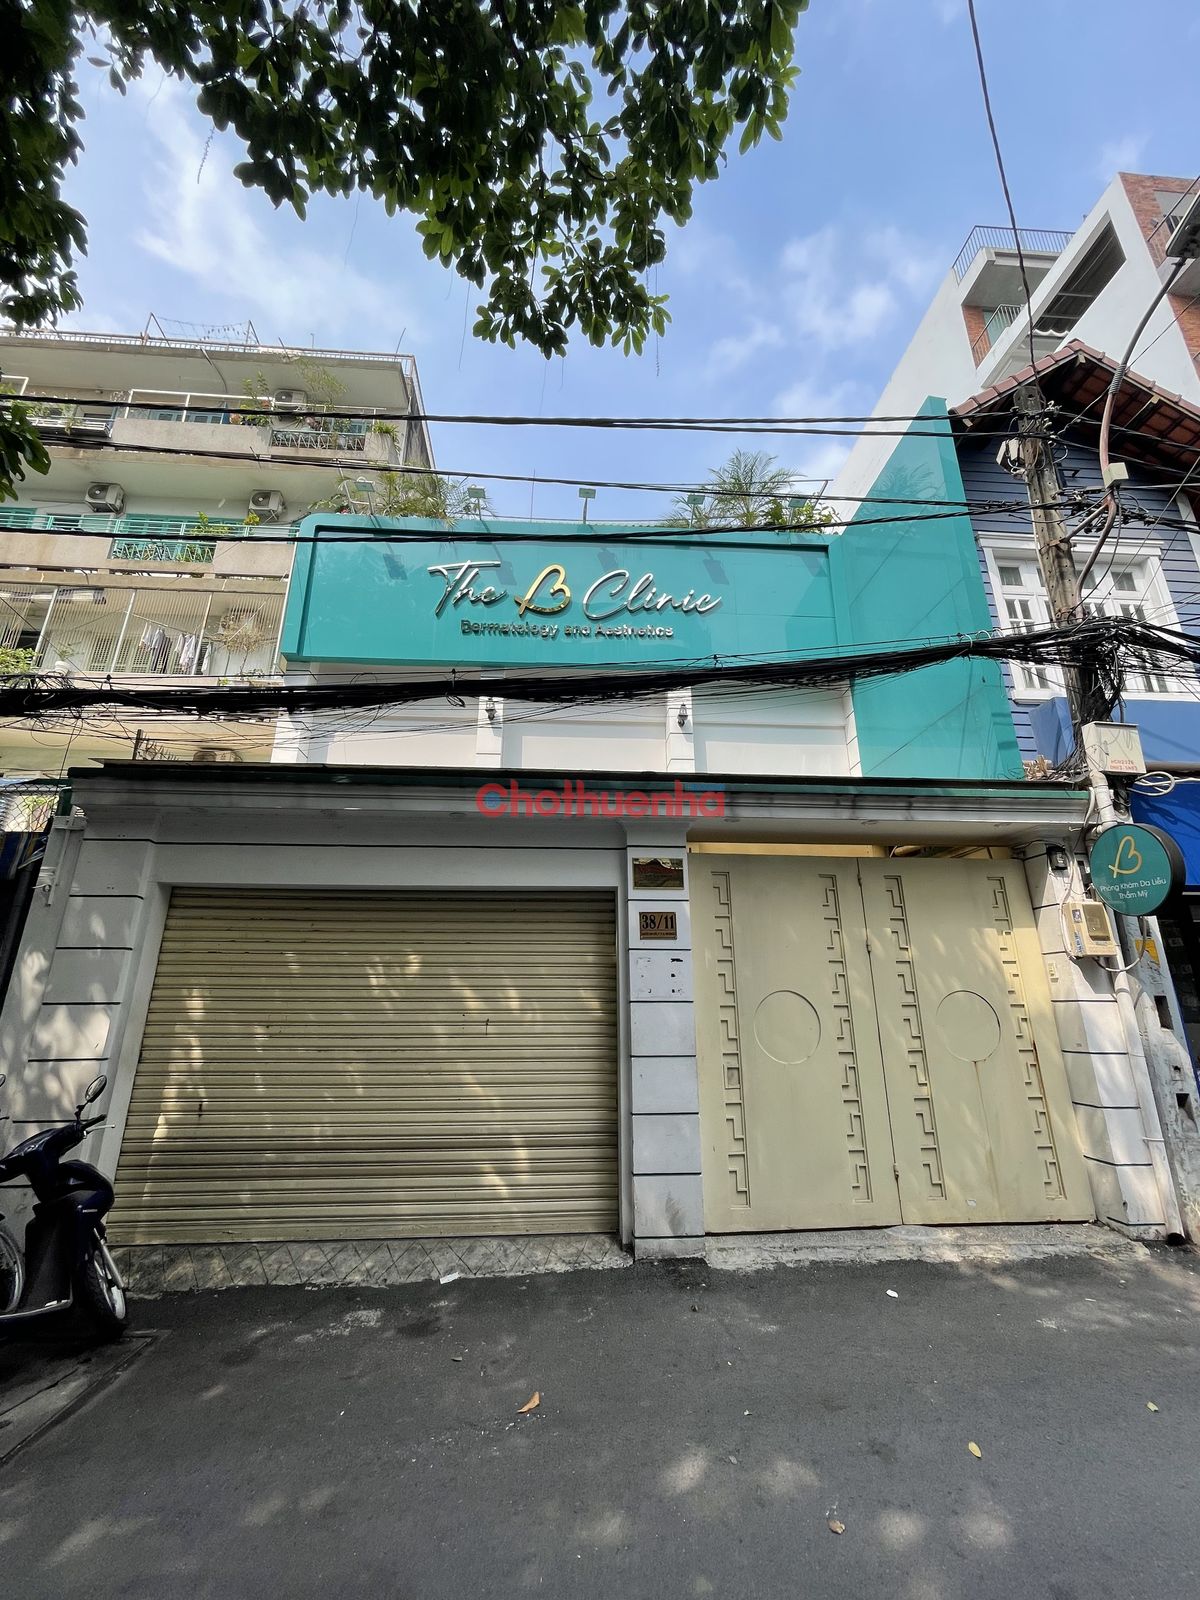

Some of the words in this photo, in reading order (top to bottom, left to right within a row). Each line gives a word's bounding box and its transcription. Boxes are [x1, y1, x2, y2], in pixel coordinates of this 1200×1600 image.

[427, 559, 507, 616] The
[583, 569, 722, 620] Clinic
[461, 619, 558, 639] Dermatology
[564, 623, 591, 637] and
[594, 622, 675, 638] Aesthetics
[641, 914, 675, 930] 38/11
